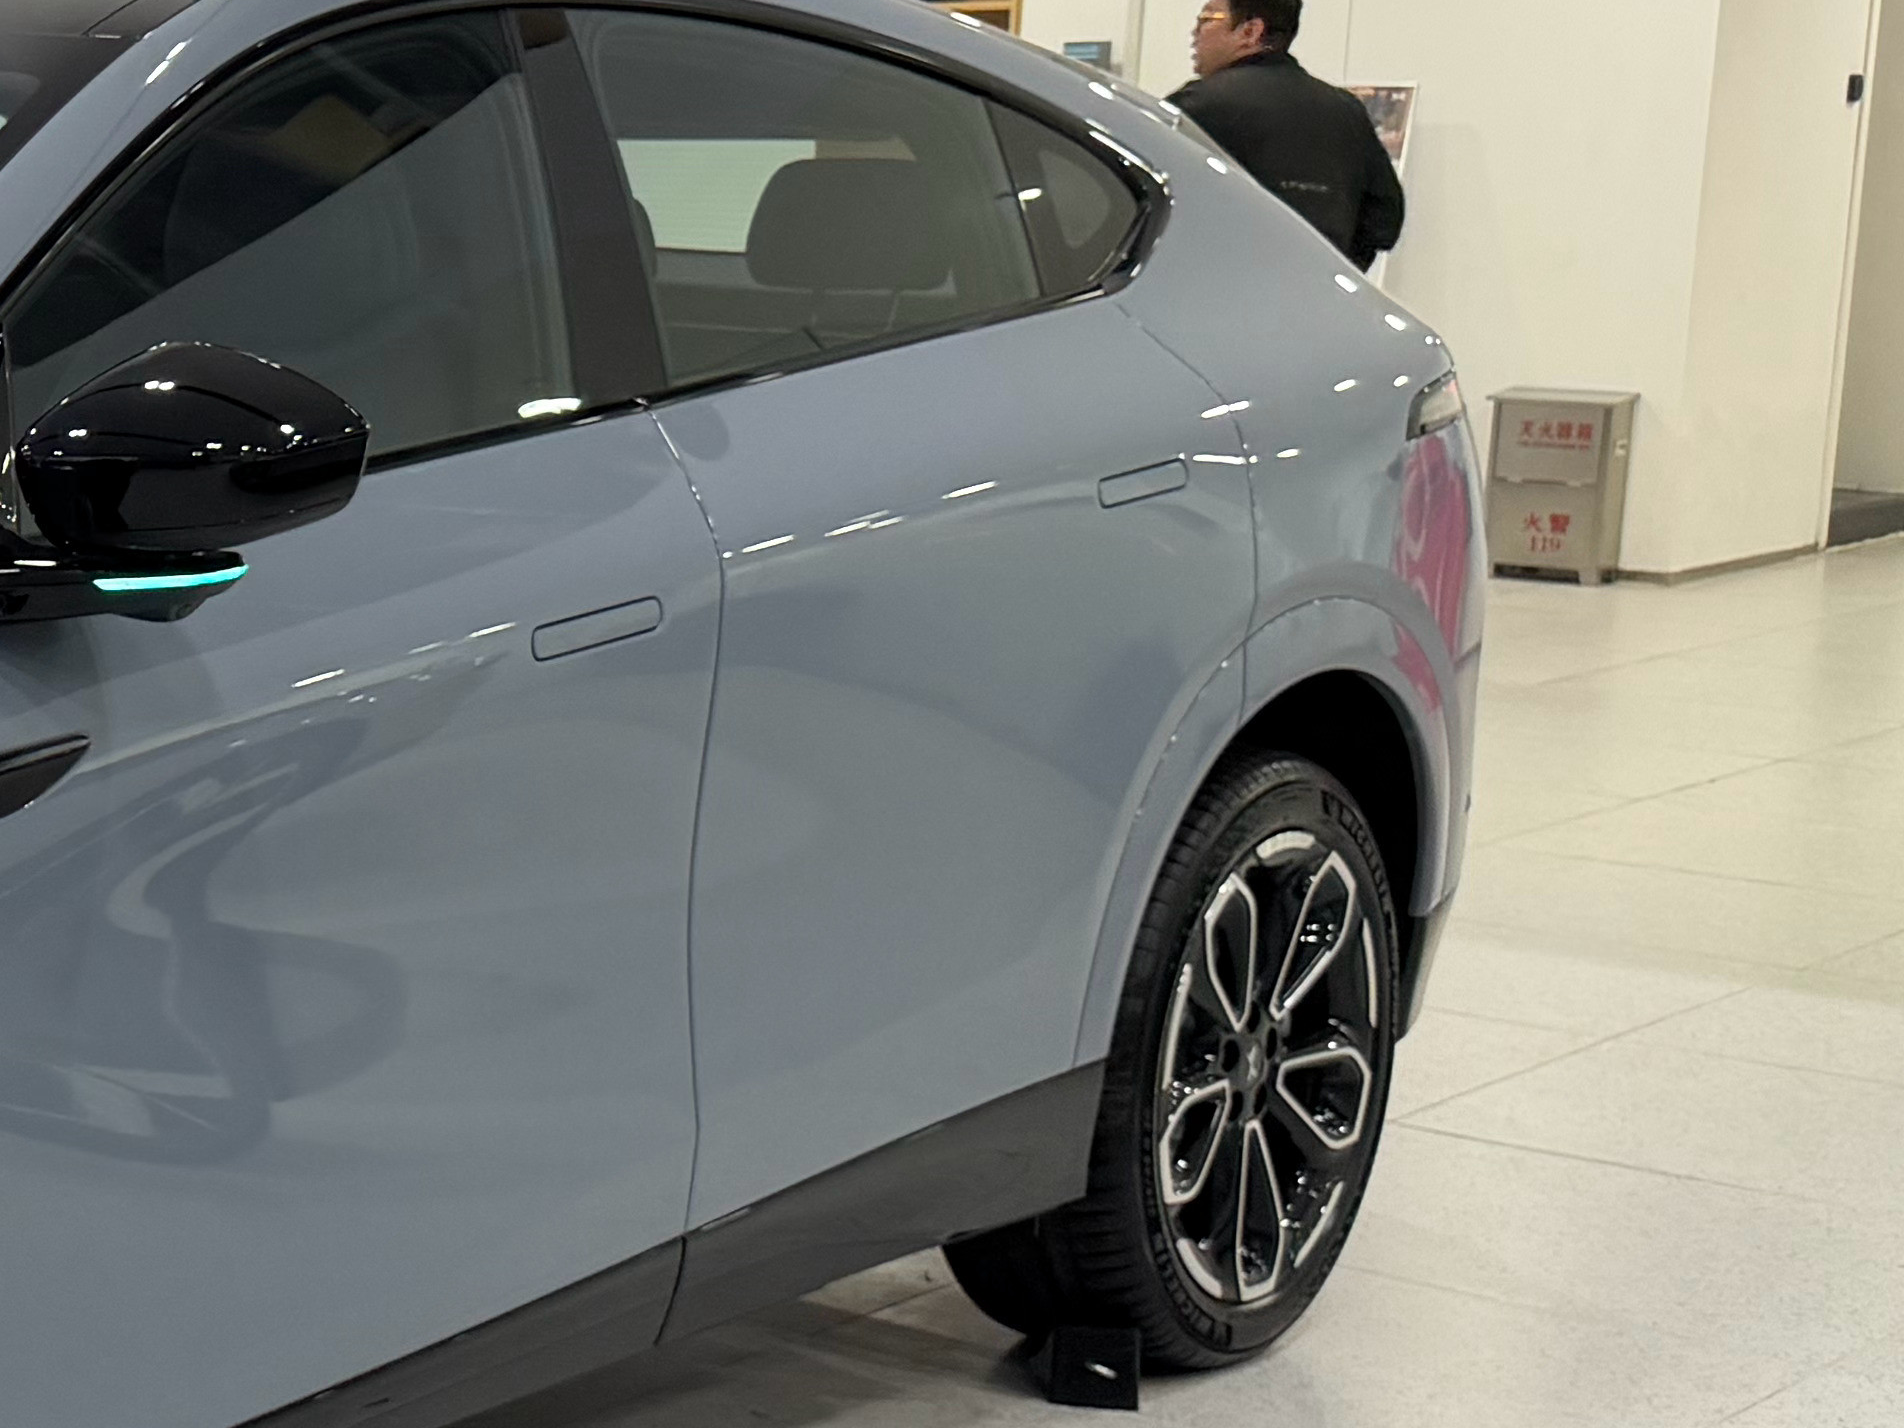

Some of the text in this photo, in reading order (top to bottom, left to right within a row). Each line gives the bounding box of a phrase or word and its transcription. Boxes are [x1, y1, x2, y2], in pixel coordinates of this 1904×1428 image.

[1520, 420, 1593, 440] 灭火器箱
[1524, 512, 1570, 535] 火警
